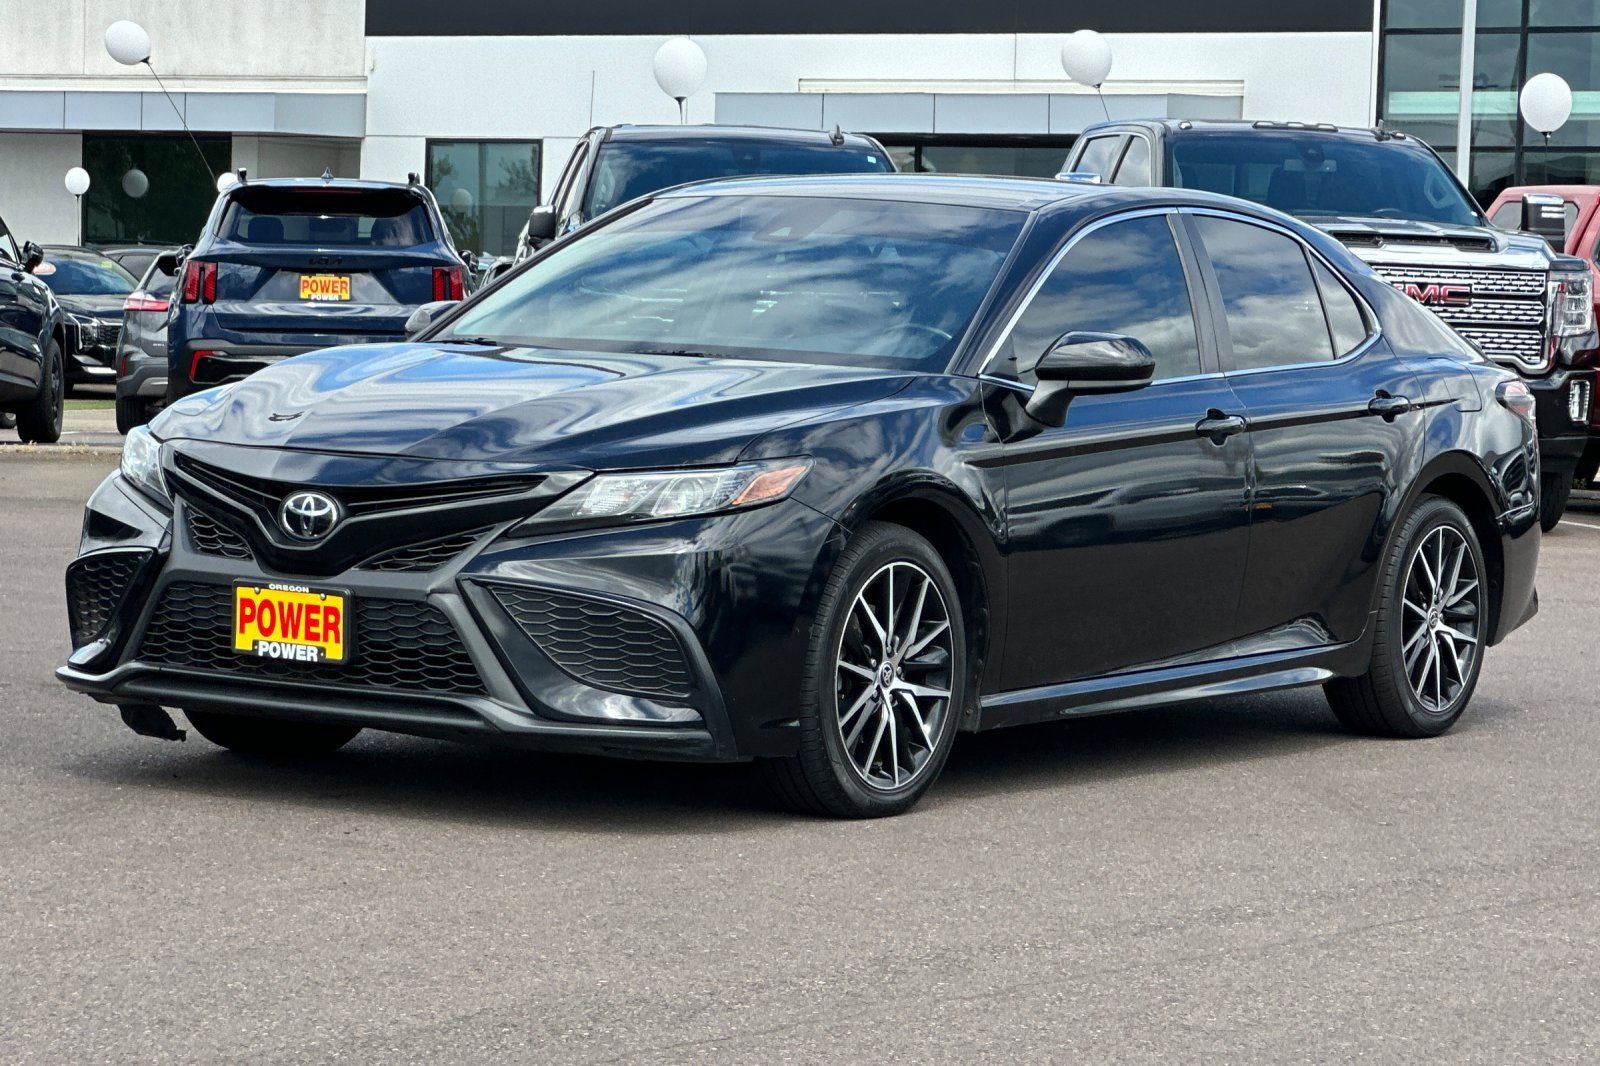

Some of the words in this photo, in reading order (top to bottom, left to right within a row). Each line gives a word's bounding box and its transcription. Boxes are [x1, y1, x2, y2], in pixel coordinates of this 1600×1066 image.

[302, 280, 348, 294] POWER
[1392, 283, 1470, 305] MC
[268, 583, 310, 593] OREGON
[239, 597, 341, 644] POWER
[258, 640, 319, 662] POWER
